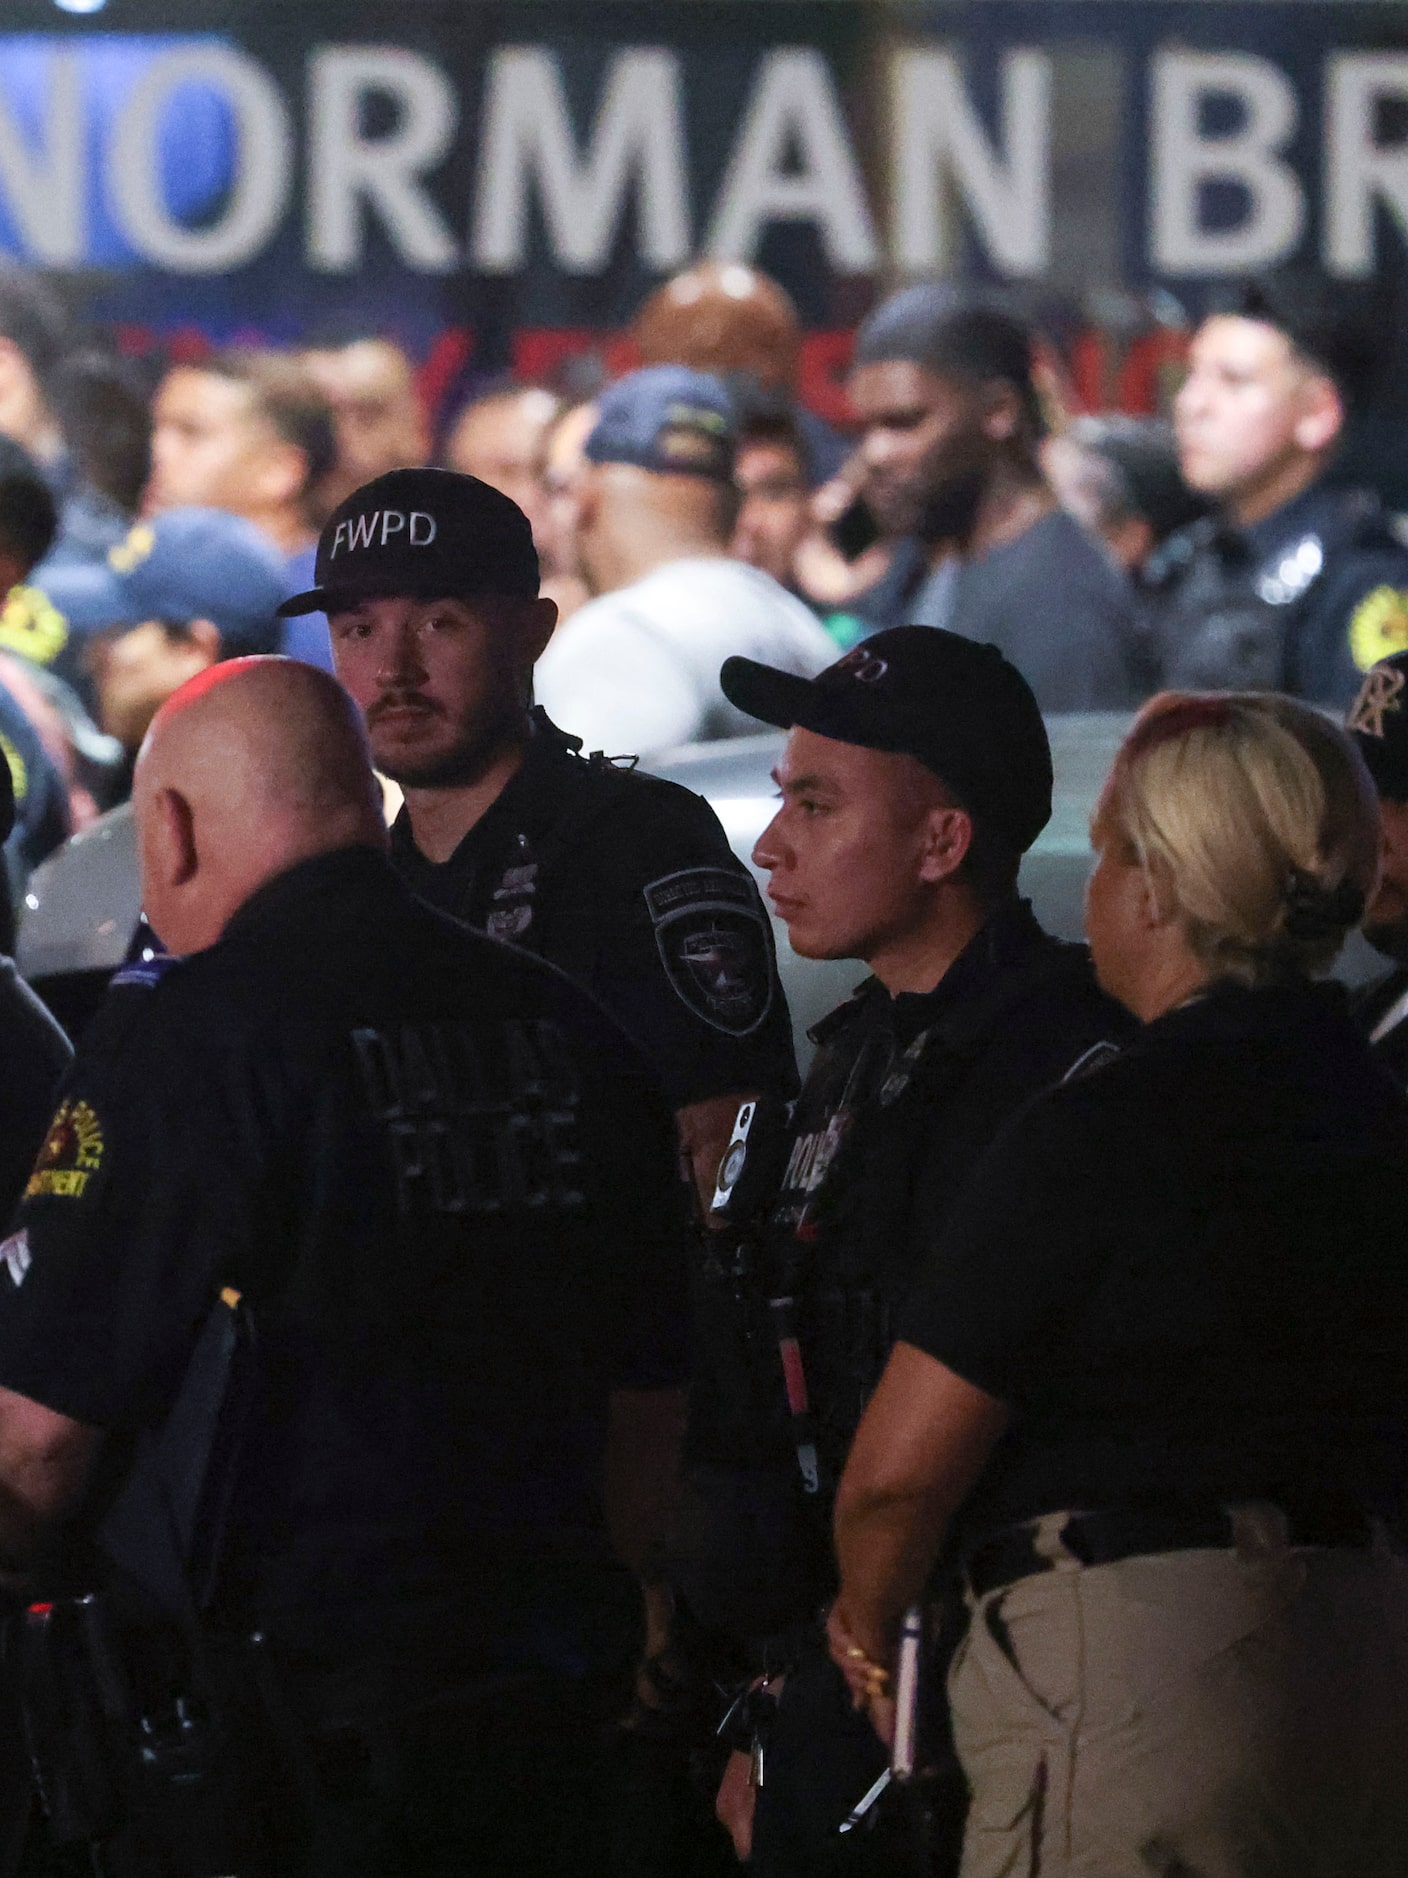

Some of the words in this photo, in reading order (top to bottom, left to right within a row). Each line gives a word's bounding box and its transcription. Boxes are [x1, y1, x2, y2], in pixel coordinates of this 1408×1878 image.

[329, 510, 438, 560] FWPD
[351, 1018, 580, 1119] DALLAS
[387, 1112, 586, 1214] POLICE
